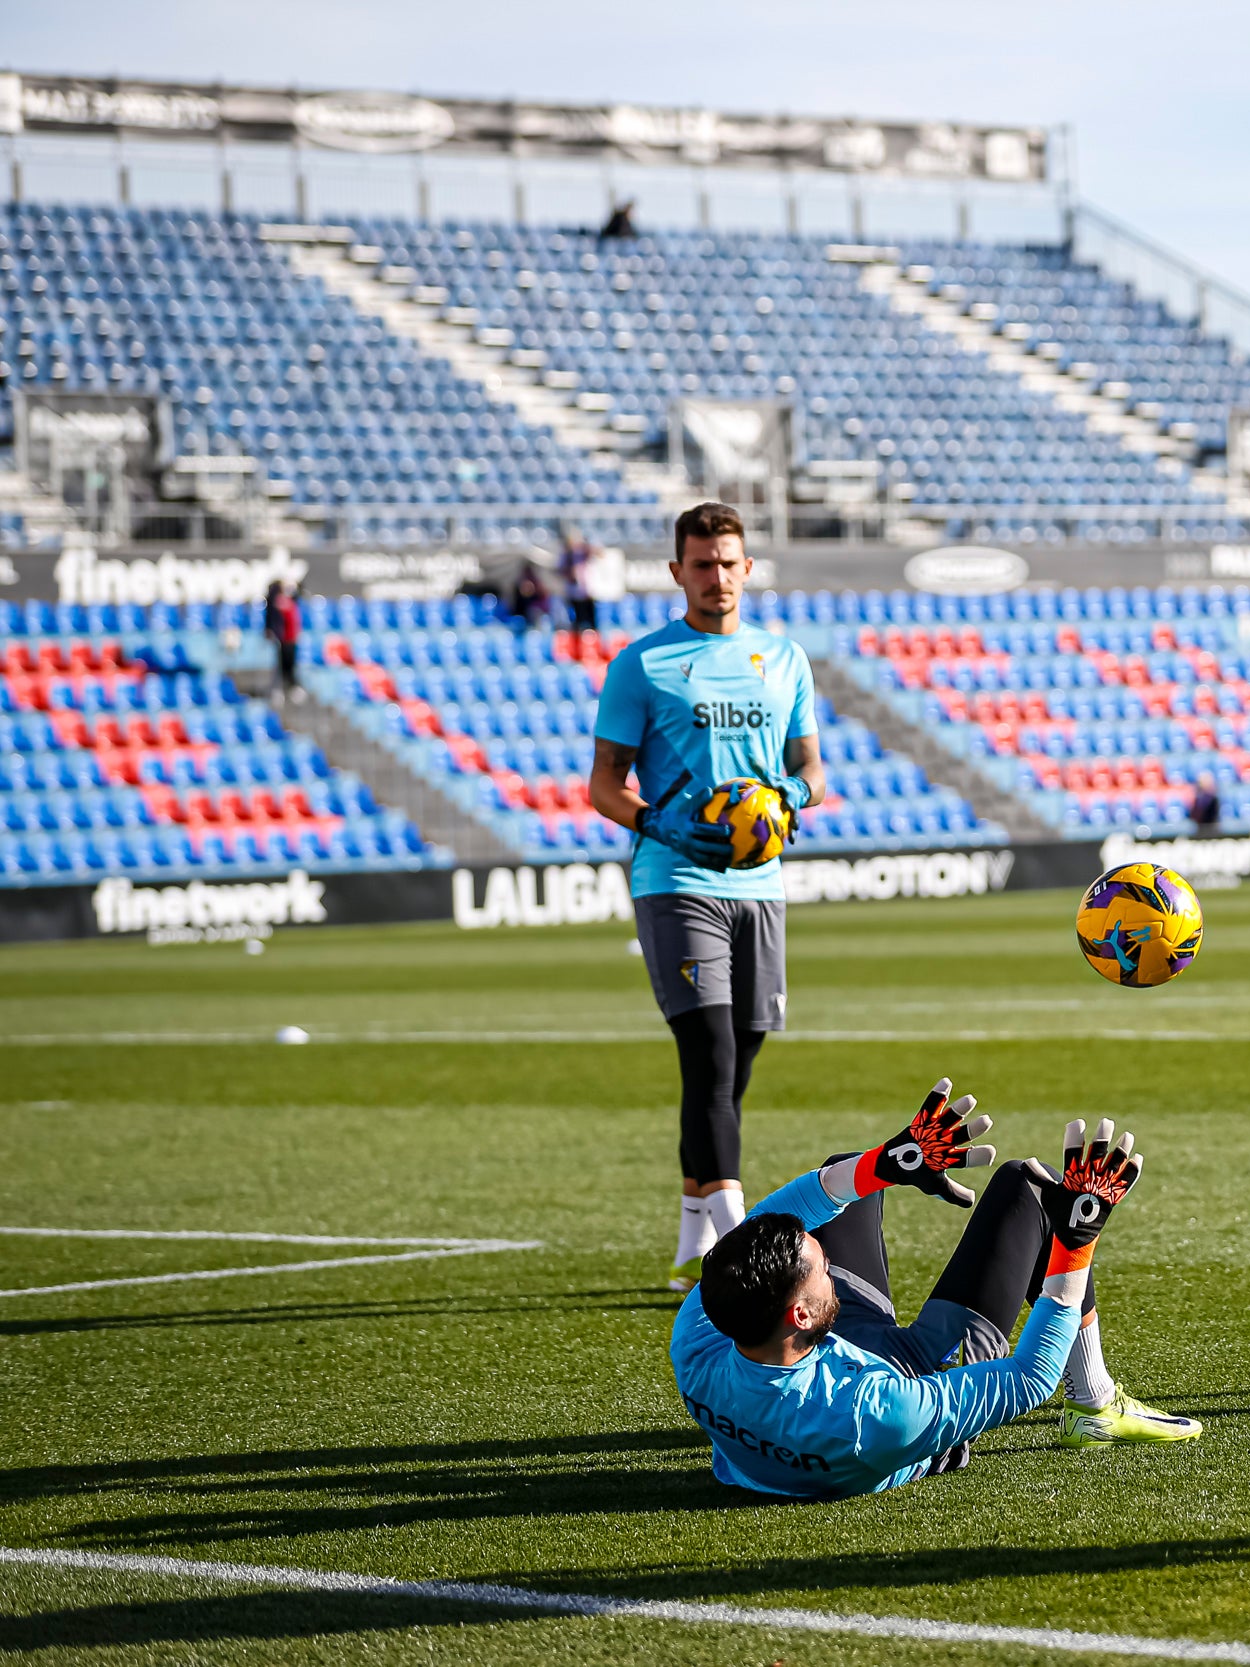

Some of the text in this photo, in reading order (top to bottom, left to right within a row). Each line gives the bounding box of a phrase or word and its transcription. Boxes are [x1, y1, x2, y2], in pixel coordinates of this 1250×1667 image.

[55, 544, 308, 604] finetwork
[92, 869, 328, 933] finetwork
[452, 852, 988, 928] LALIGA ERMOTION
